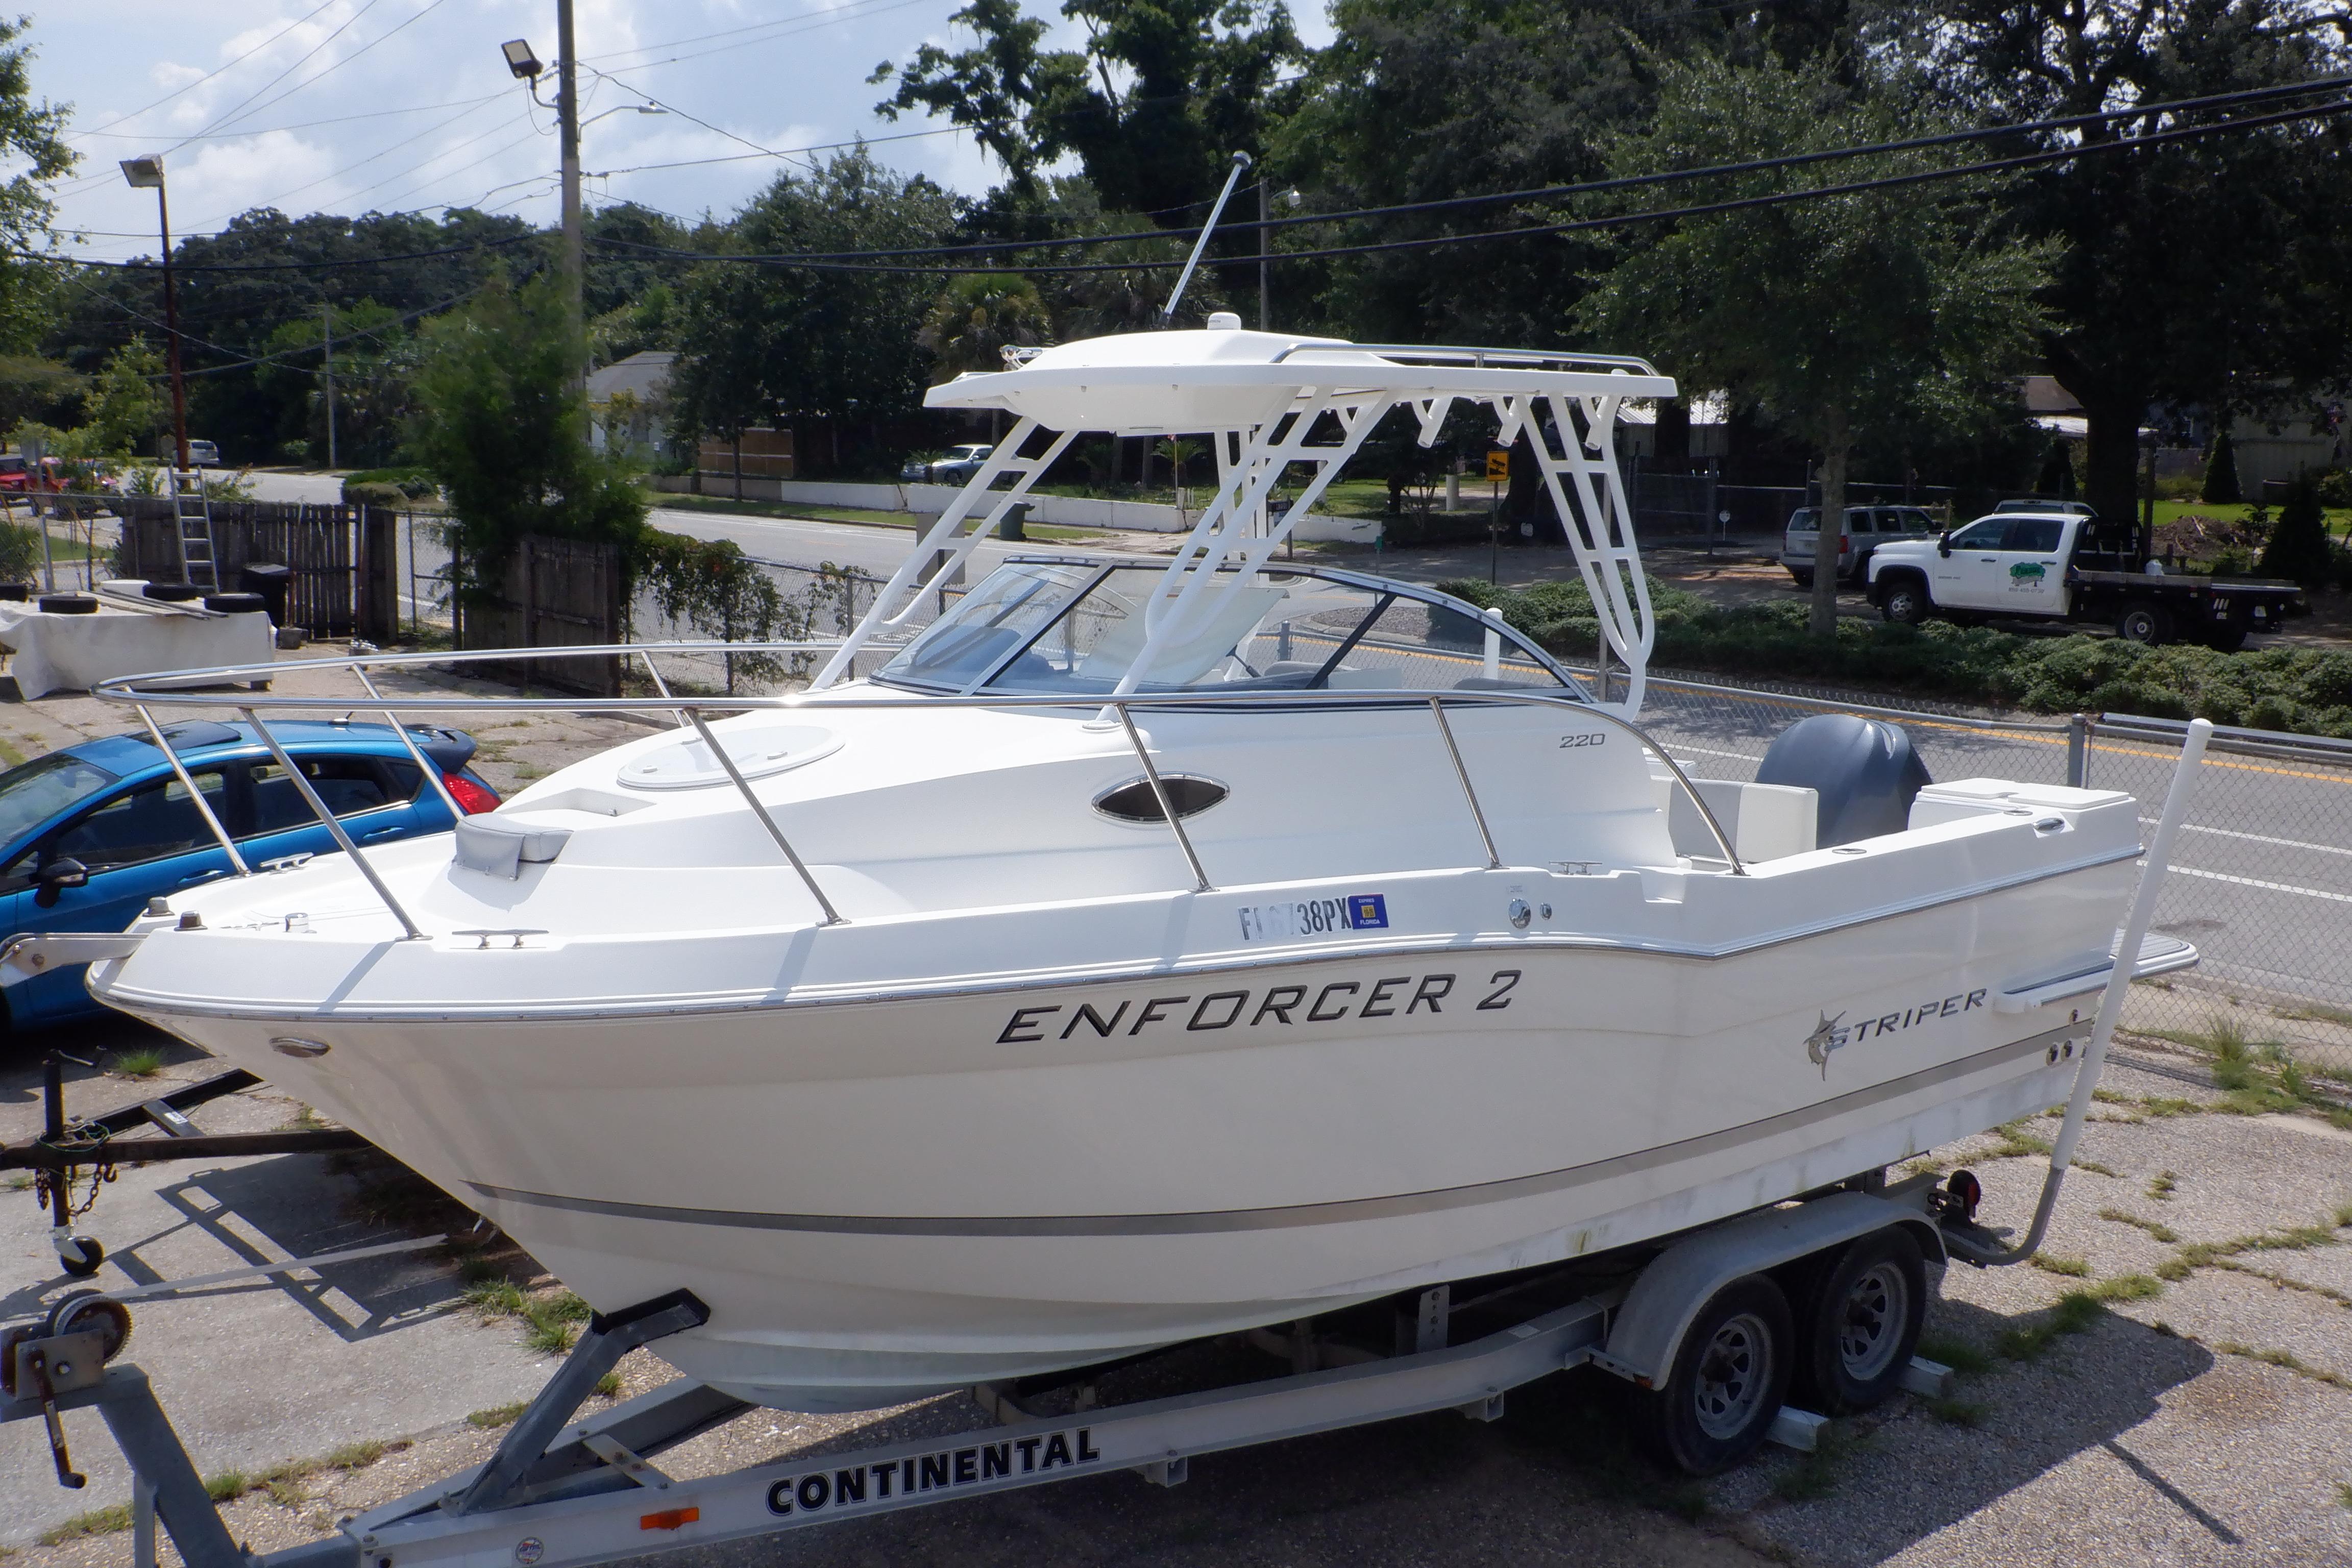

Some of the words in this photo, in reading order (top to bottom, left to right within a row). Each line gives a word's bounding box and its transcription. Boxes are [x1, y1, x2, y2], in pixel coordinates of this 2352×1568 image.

[1559, 733, 1605, 749] 220
[995, 972, 1457, 1045] ENFORCER
[1476, 969, 1522, 1011] 2
[1824, 988, 1988, 1051] STRIPER
[766, 1428, 1100, 1517] CONTINENTAL
